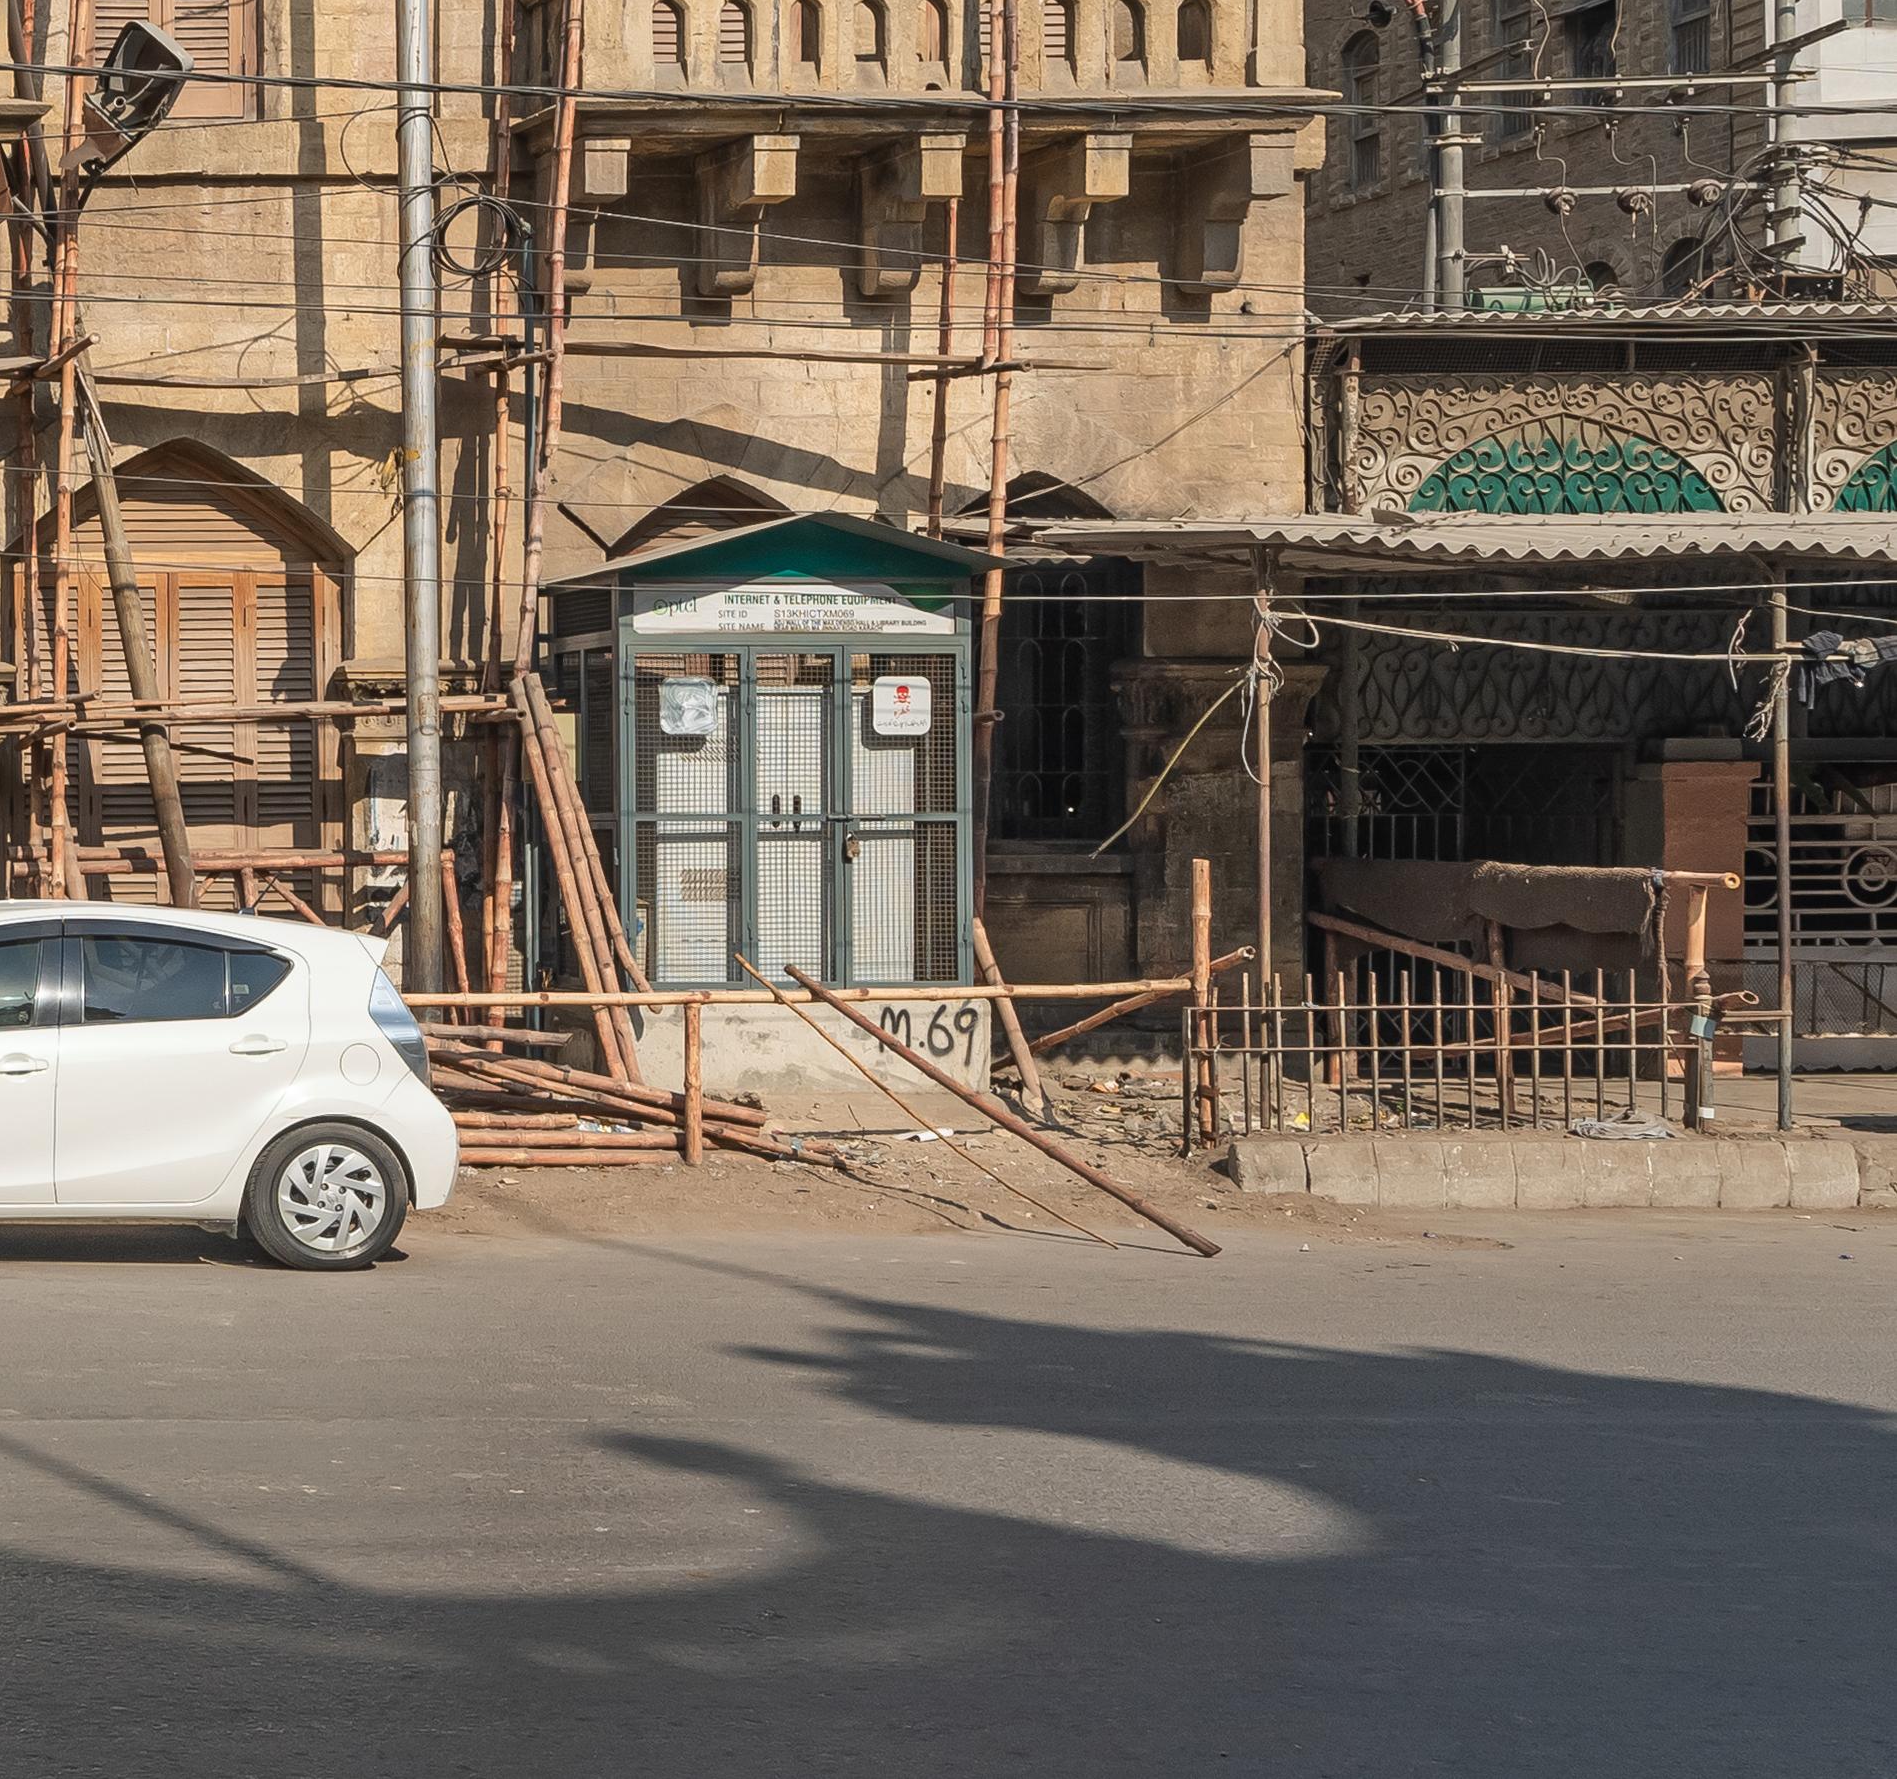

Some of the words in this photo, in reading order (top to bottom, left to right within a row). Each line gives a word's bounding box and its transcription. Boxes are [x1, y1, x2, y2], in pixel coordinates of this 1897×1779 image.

[724, 595, 770, 605] INTERNET
[773, 596, 781, 605] &
[784, 595, 839, 606] TELEPHONE
[841, 595, 897, 606] EQUIPMENT
[668, 596, 698, 617] ptcl
[718, 609, 736, 619] SITE
[739, 610, 748, 619] ID
[718, 622, 736, 631] SITE
[738, 623, 766, 632] NAME
